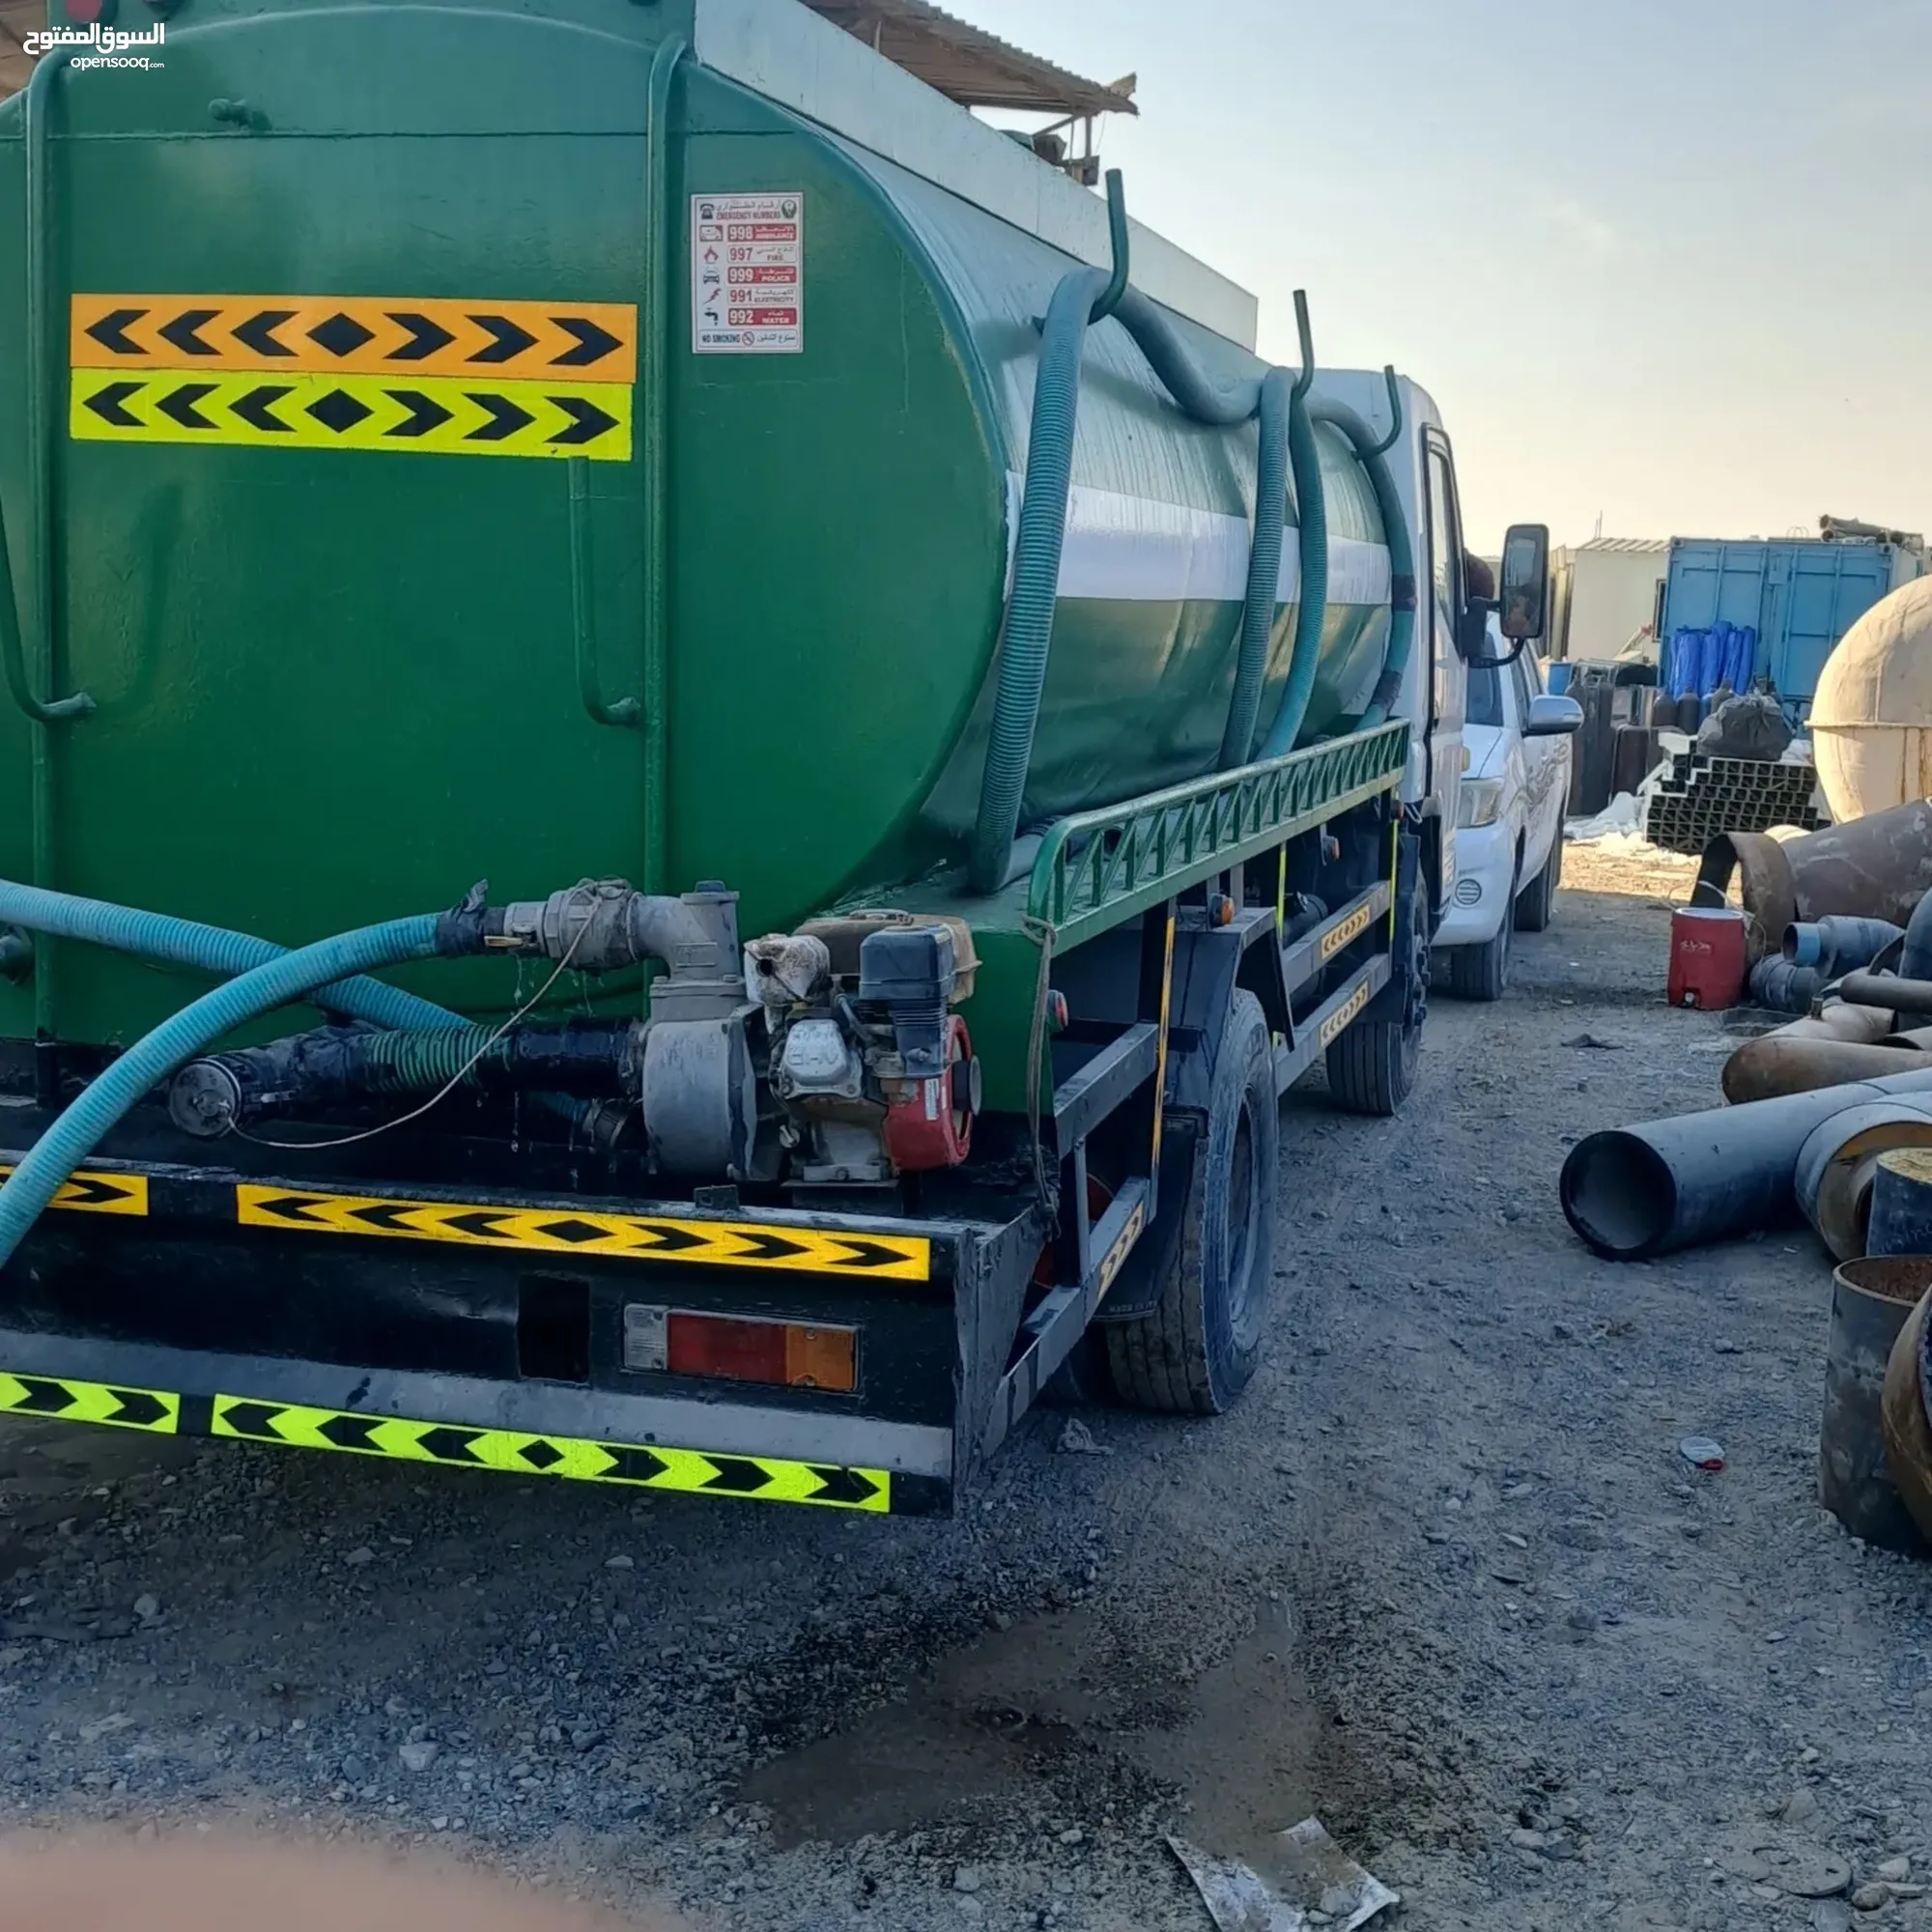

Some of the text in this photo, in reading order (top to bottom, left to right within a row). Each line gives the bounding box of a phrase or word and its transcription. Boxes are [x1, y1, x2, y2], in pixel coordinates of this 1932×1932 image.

[716, 211, 752, 221] EMERGENCY
[729, 225, 753, 241] 998
[729, 247, 753, 261] 997
[729, 268, 753, 283] 999
[729, 289, 753, 303] 991
[729, 309, 753, 325] 992
[701, 333, 741, 344] NO SMOKING
